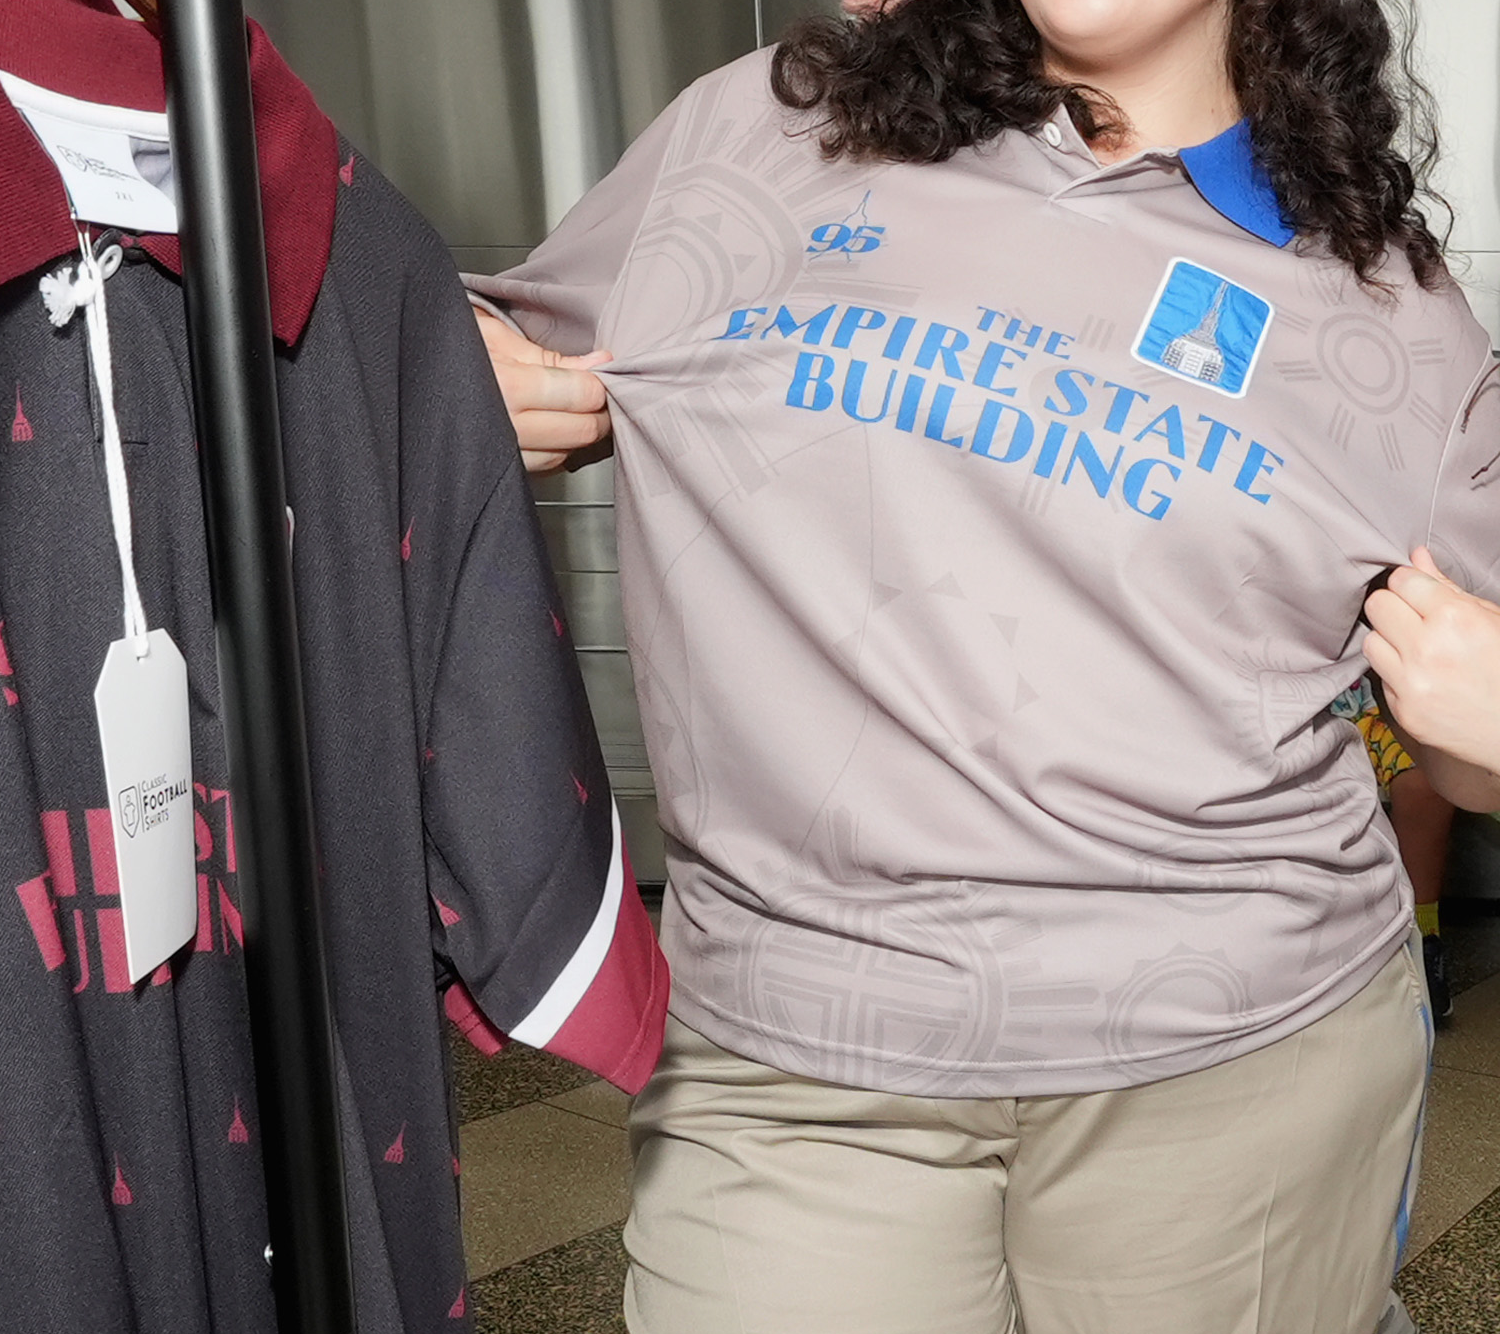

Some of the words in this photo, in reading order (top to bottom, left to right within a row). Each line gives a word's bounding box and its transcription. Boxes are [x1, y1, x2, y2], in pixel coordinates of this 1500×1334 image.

[805, 223, 885, 253] 95
[976, 305, 1077, 361] THE
[711, 303, 1030, 398] EMPIRE
[1043, 367, 1286, 506] STATE
[785, 353, 1182, 521] BUILDING
[143, 779, 188, 814] FOOTBALL
